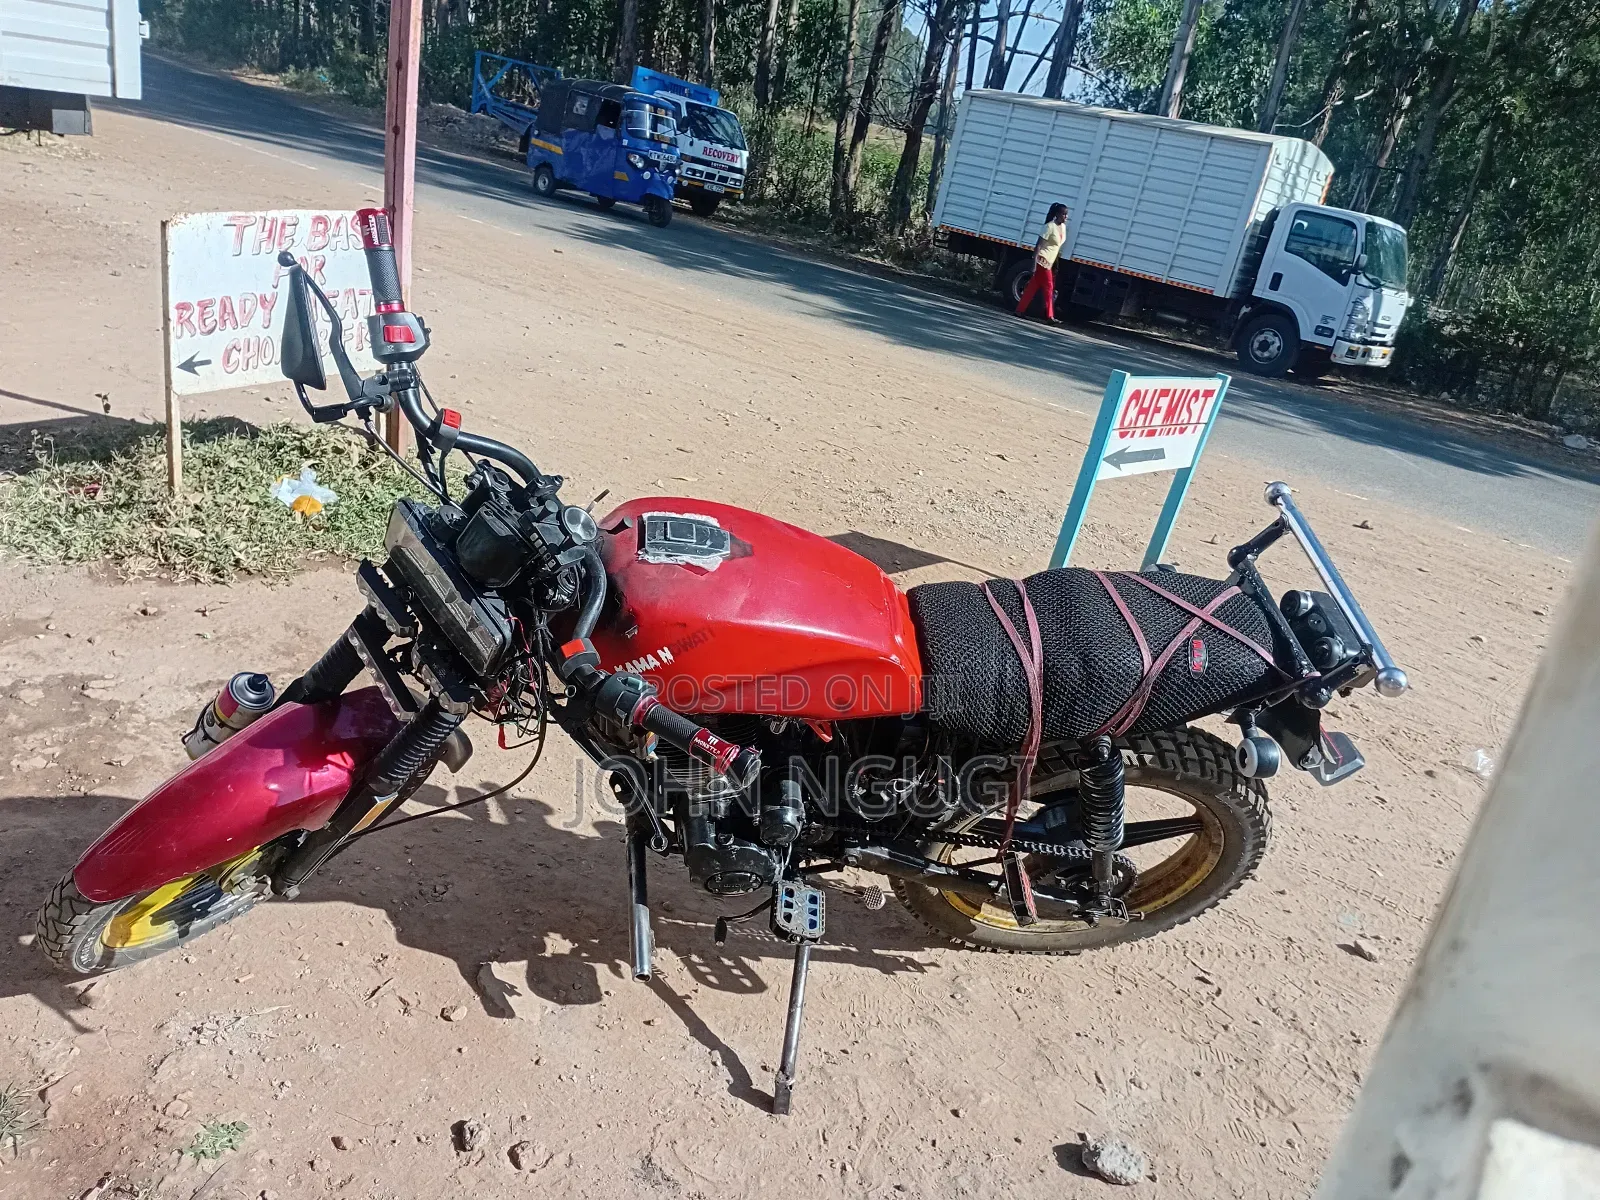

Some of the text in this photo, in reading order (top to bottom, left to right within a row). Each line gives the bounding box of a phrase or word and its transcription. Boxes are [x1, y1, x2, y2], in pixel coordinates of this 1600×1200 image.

[702, 146, 740, 163] RECOVERY
[223, 215, 301, 256] THE
[305, 213, 366, 251] BAS
[174, 287, 373, 339] READY EAT
[221, 334, 281, 374] CHO
[342, 322, 372, 351] FR
[1118, 388, 1216, 439] CHEMIST
[1192, 639, 1204, 672] KTM
